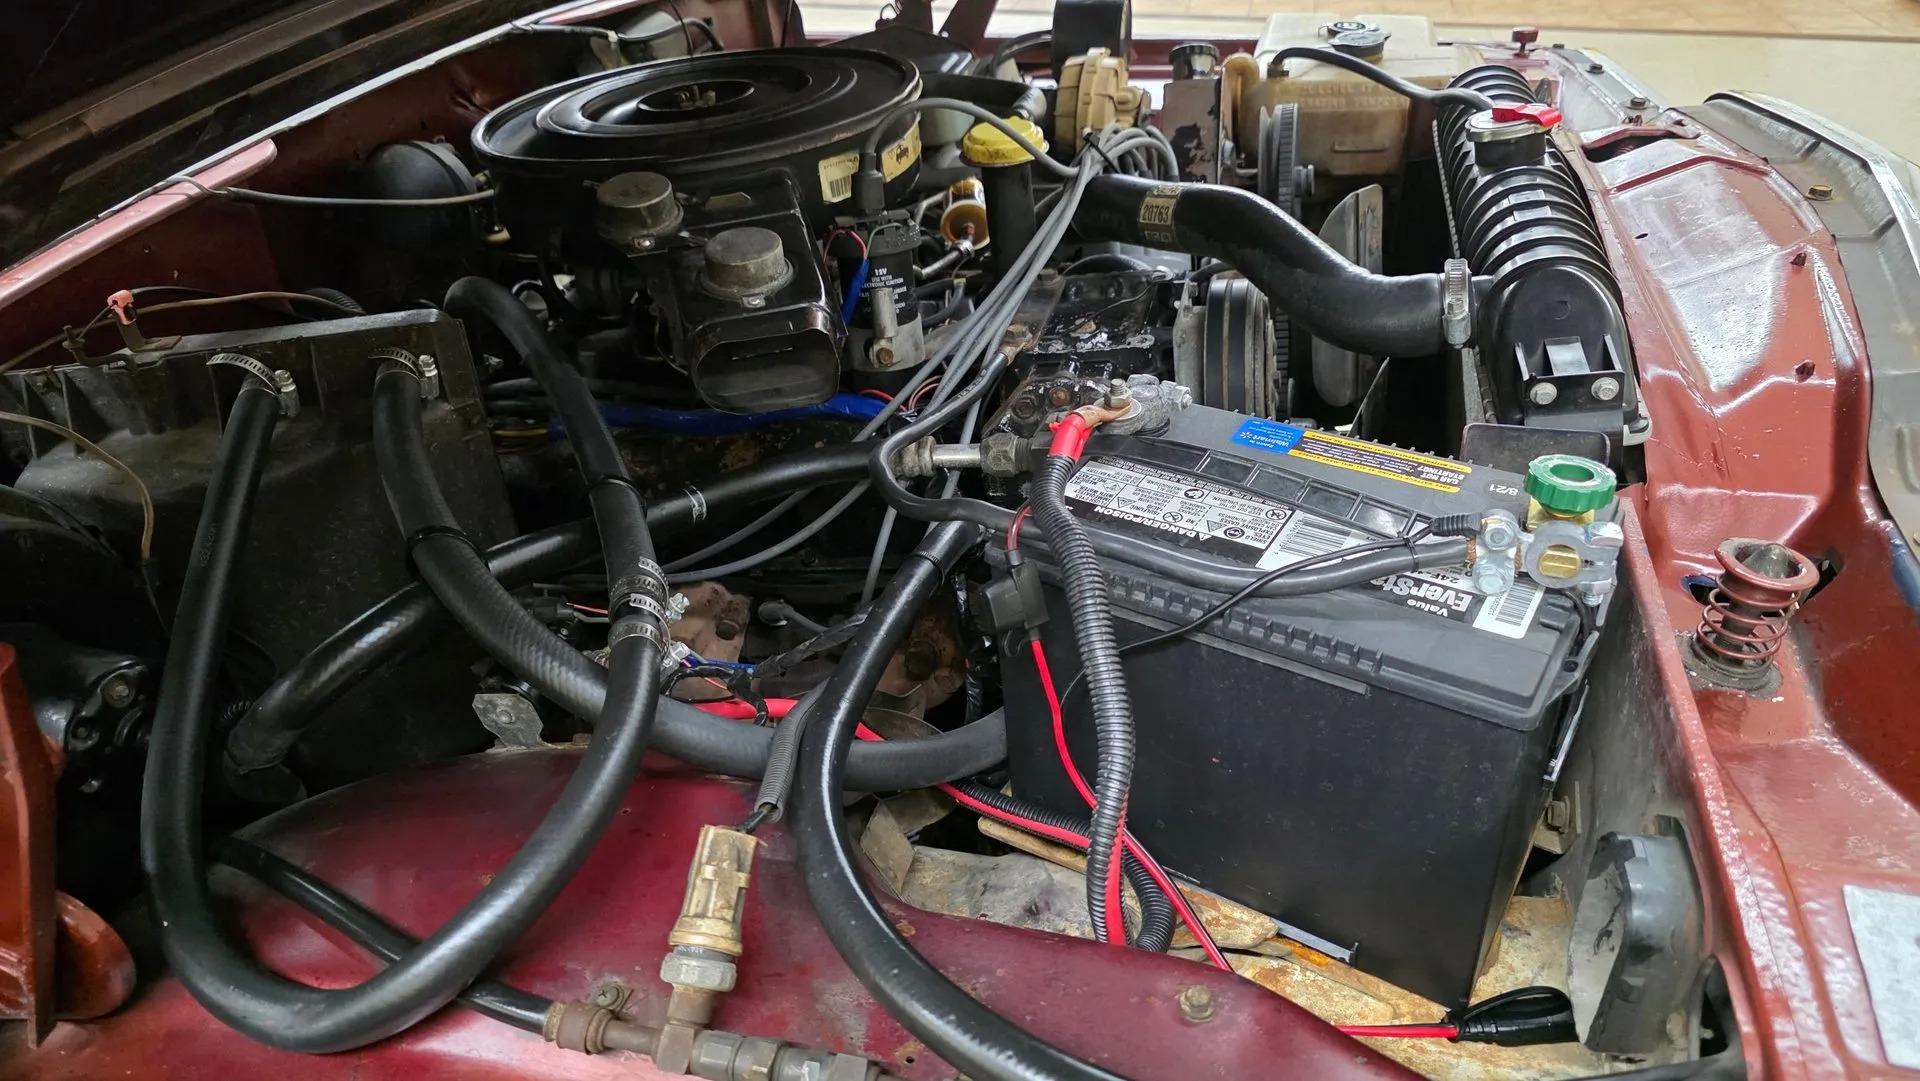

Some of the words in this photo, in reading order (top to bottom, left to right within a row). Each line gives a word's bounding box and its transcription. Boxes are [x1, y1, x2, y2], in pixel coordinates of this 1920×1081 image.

[1142, 204, 1169, 223] 20763
[875, 268, 887, 276] 12V
[1252, 434, 1289, 446] Walmart
[1416, 464, 1465, 480] STARTING?
[1419, 472, 1439, 480] NOT
[1439, 476, 1459, 484] CAR
[1489, 483, 1518, 496] 8/21
[1130, 504, 1157, 514] SULFURIC
[1093, 505, 1196, 537] DANGER/POISON
[1217, 512, 1246, 523] BLINDNESS
[1219, 518, 1239, 526] GASES
[1240, 523, 1273, 535] EXPLOSIVE
[1244, 535, 1267, 544] SHIELD
[1406, 599, 1449, 618] Value
